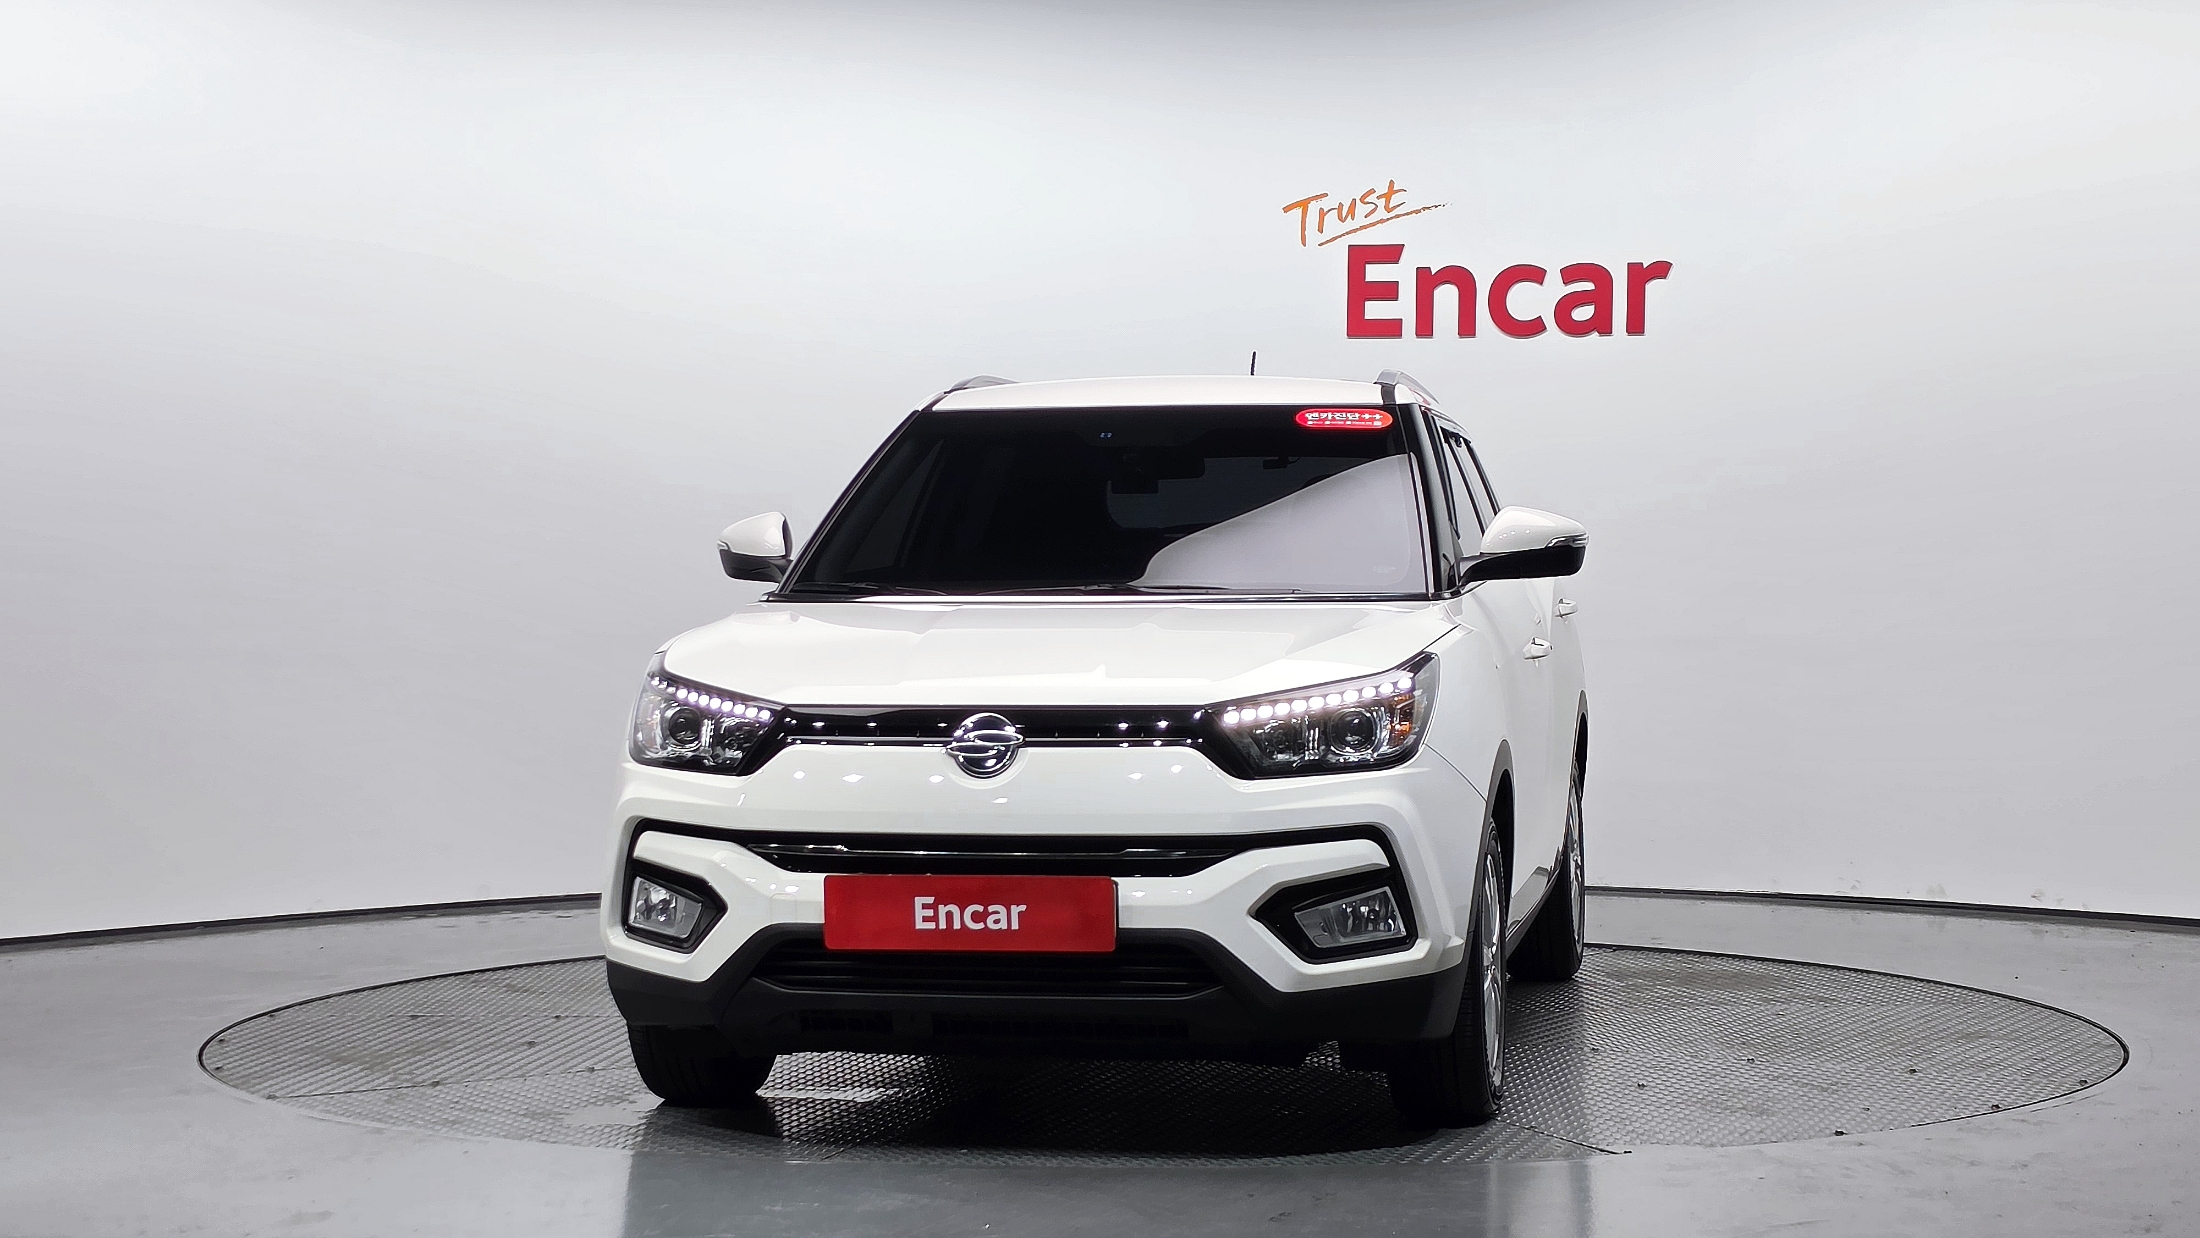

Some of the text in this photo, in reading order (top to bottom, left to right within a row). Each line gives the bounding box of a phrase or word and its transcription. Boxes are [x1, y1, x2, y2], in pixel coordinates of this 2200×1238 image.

[1282, 179, 1407, 246] Trust
[1346, 243, 1673, 338] Encar
[914, 896, 1027, 930] Encar
